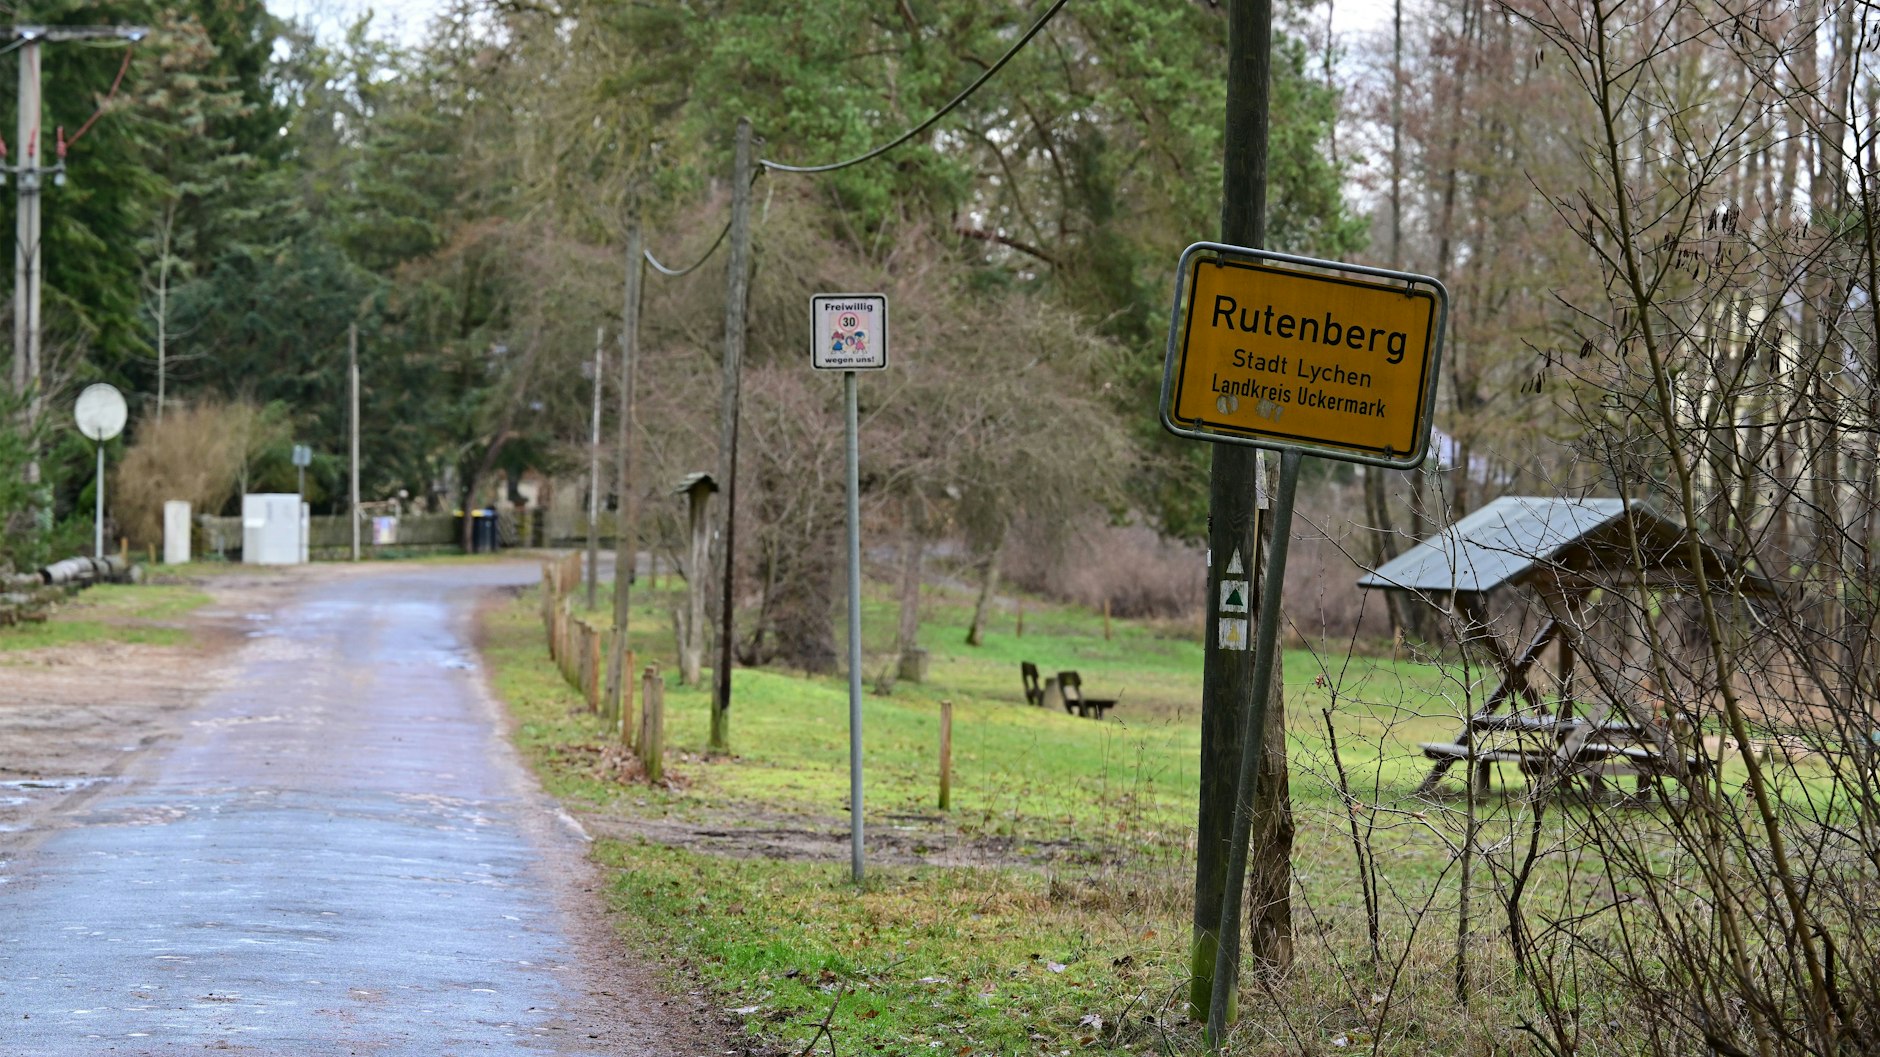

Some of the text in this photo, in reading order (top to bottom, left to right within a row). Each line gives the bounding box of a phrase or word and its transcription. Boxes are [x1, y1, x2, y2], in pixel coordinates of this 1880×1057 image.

[825, 303, 873, 312] Freiwillig
[843, 317, 855, 327] 30
[1212, 294, 1407, 364] Rutenberg
[1232, 349, 1372, 388] Stadt Lychen
[1212, 373, 1386, 418] Landkreis Uckermark
